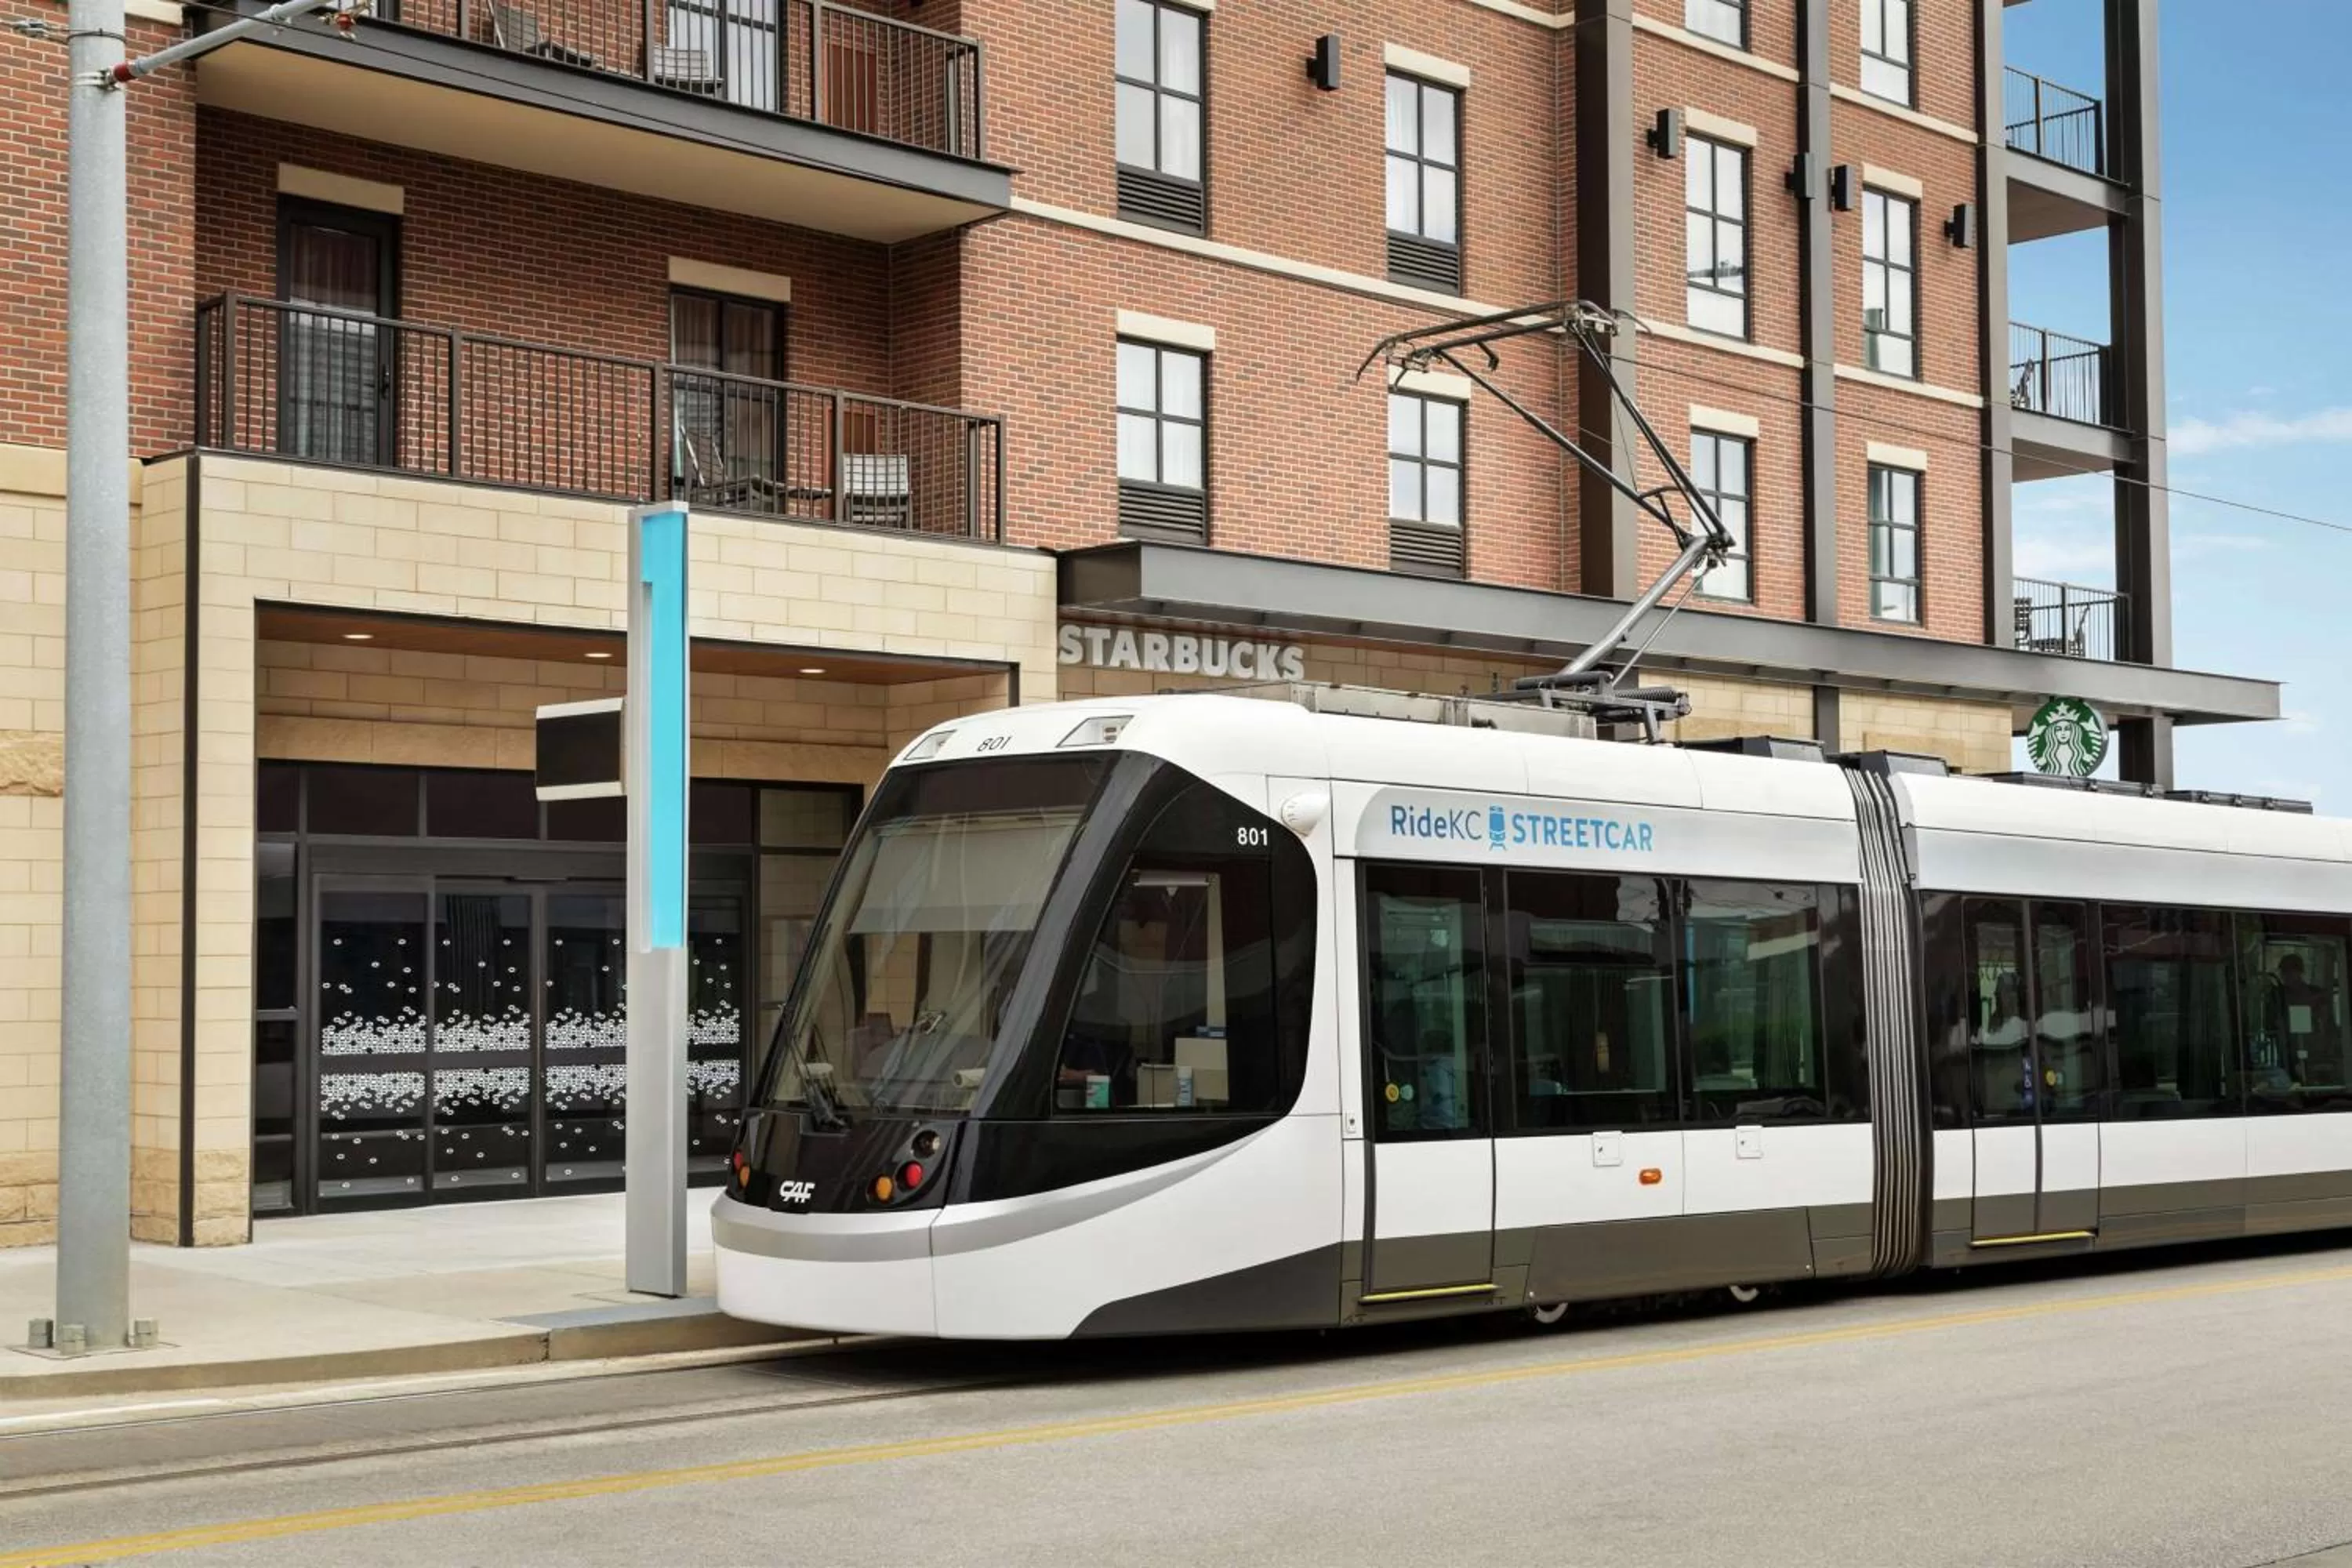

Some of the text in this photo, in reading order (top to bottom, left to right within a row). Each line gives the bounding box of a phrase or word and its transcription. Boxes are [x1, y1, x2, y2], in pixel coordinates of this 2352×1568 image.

[1058, 624, 1305, 681] STARBUCKS
[977, 735, 1011, 752] 801
[1237, 828, 1269, 846] 801
[1391, 804, 1653, 851] RideKC STREETCAR
[779, 1180, 815, 1203] CAF
